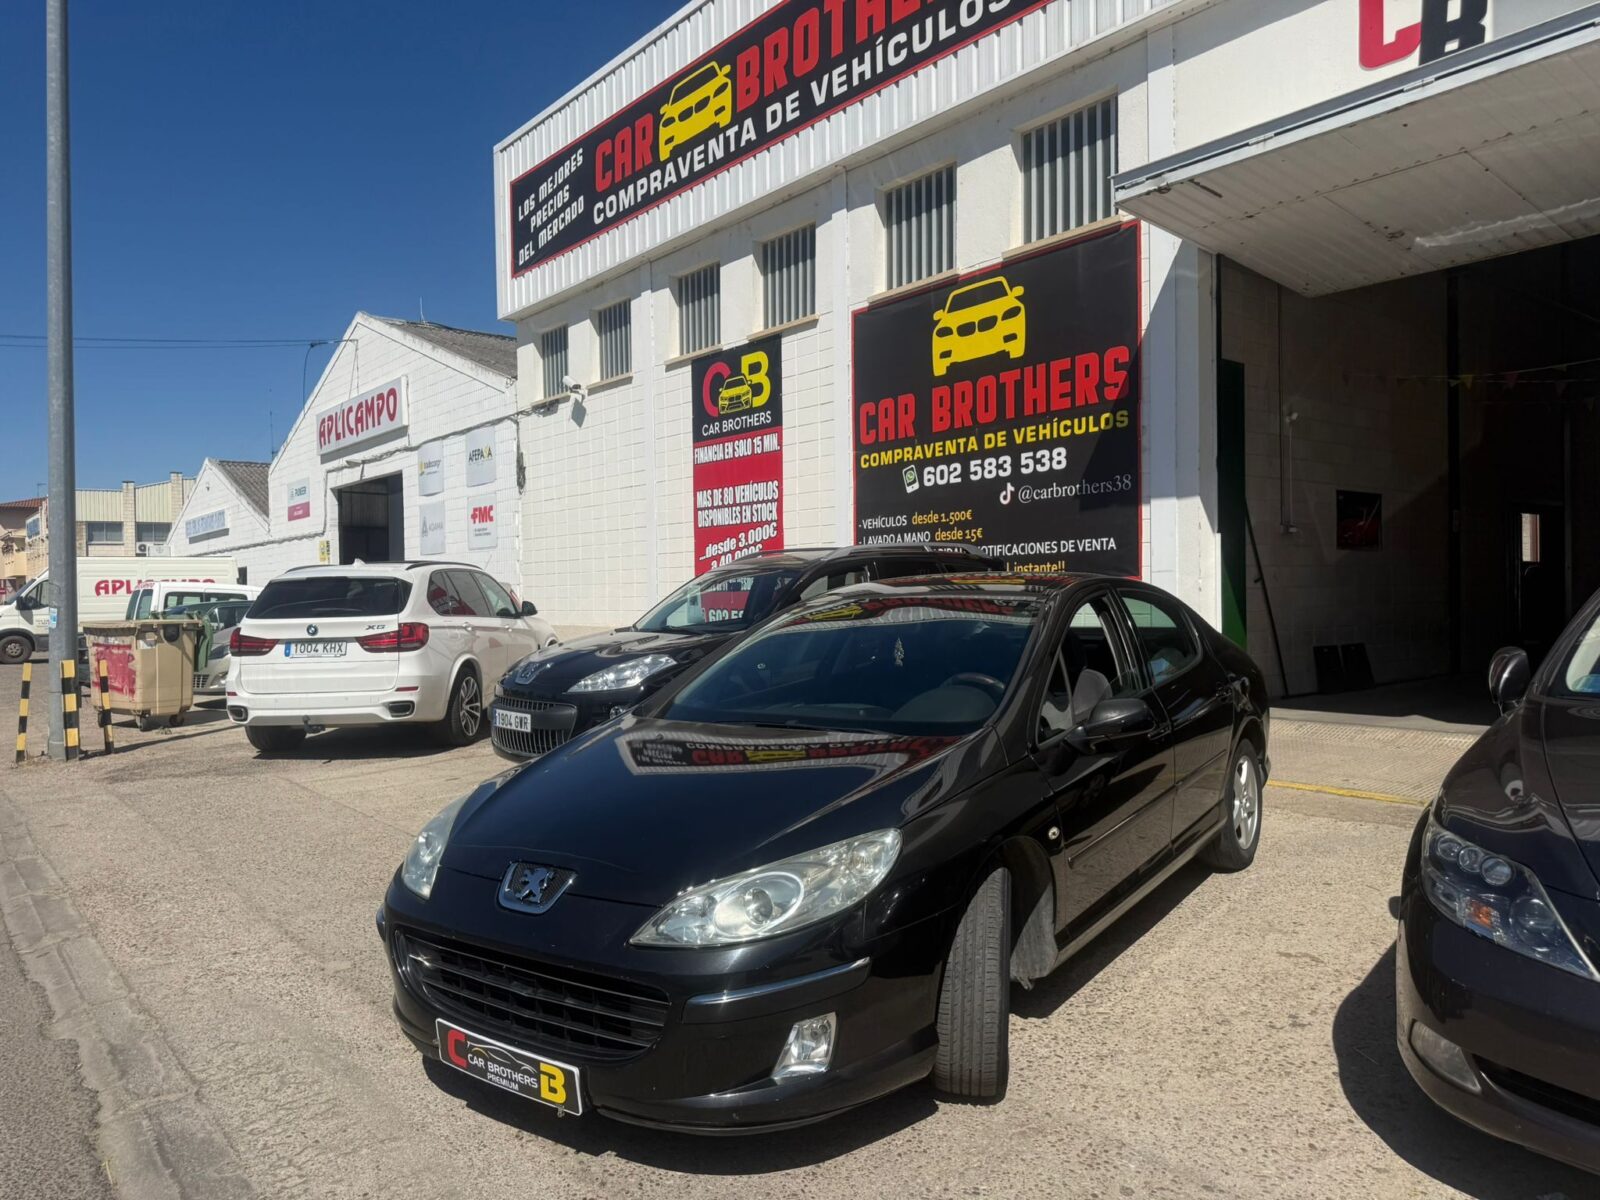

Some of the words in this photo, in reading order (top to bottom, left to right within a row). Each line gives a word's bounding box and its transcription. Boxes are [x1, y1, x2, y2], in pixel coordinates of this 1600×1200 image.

[595, 112, 654, 193] CAR
[736, 0, 932, 113] BROTH
[593, 117, 757, 225] COMPRAVENTA
[766, 90, 800, 133] DE
[518, 193, 536, 222] LOS
[538, 147, 584, 203] MEJORES
[530, 184, 570, 233] PRECIOS
[518, 240, 536, 266] DEL
[538, 195, 585, 249] MERCADO
[859, 393, 916, 445] CAR
[932, 345, 1130, 433] BROTHERS
[318, 387, 398, 450] APLICAMPO
[702, 422, 720, 437] CAR
[722, 410, 772, 433] BROTHERS
[694, 443, 724, 465] FINANCIA
[724, 441, 734, 460] EN
[734, 438, 752, 458] SOLO
[753, 436, 762, 454] 15
[763, 433, 780, 453] MIN.
[860, 436, 979, 469] COMPRAVENTA
[984, 430, 1007, 450] DE
[1013, 410, 1129, 445] VEHÍCULOS
[923, 463, 962, 487] 602
[969, 455, 1012, 481] 583
[1020, 447, 1067, 475] 538
[697, 489, 712, 508] MAS
[713, 488, 722, 507] DE
[723, 486, 734, 506] 80
[735, 480, 779, 504] VEHÍCULOS
[1018, 473, 1132, 504] @carbrothers38
[471, 505, 494, 524] FMC
[698, 506, 741, 528] DISPONIBLES
[742, 504, 751, 523] EN
[752, 501, 778, 523] STOCK
[911, 510, 939, 525] desde
[941, 509, 973, 525] 1.500€
[738, 521, 778, 548] 3.000€
[904, 531, 931, 543] MANO
[935, 527, 963, 541] desde
[965, 528, 983, 542] 15€
[979, 541, 1058, 557] OTIFICACIONES
[1060, 539, 1076, 553] DE
[1077, 537, 1117, 552] VENTA
[294, 642, 319, 654] 1004
[322, 641, 344, 654] KHX
[467, 1053, 485, 1069] CAR
[487, 1061, 538, 1089] BROTHERS
[487, 1072, 519, 1091] PREMIUM
